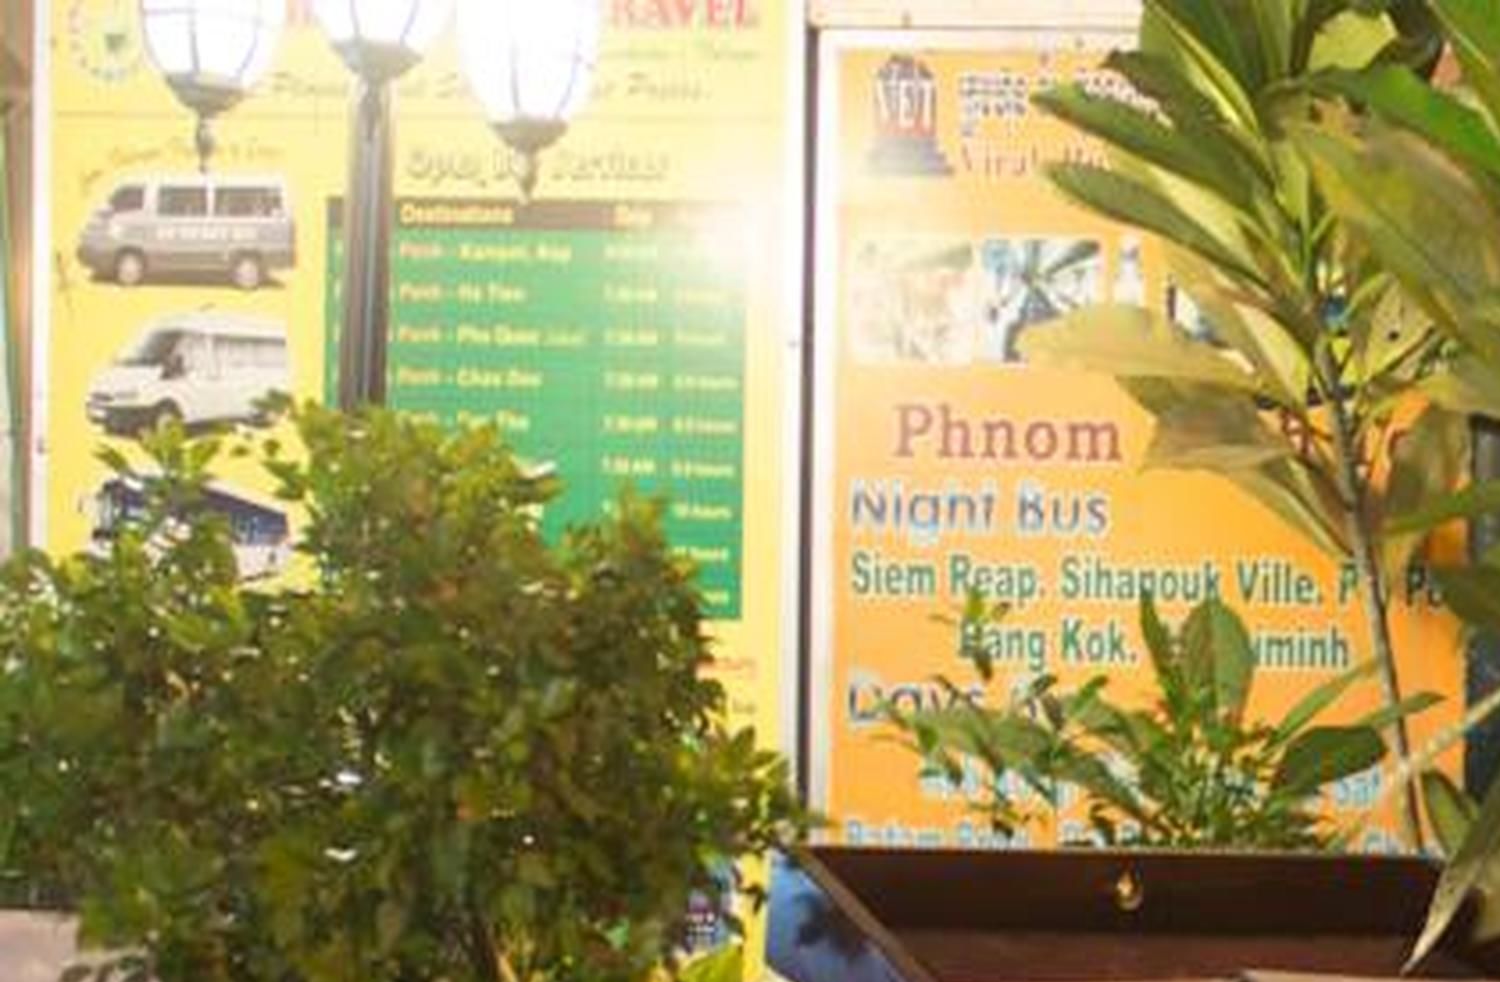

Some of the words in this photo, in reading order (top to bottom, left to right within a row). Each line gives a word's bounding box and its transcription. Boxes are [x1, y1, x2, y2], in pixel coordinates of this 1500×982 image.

[606, 0, 762, 29] RAVEL
[892, 401, 1123, 463] Phnom
[1018, 482, 1110, 535] Bus
[850, 550, 937, 595] Siem
